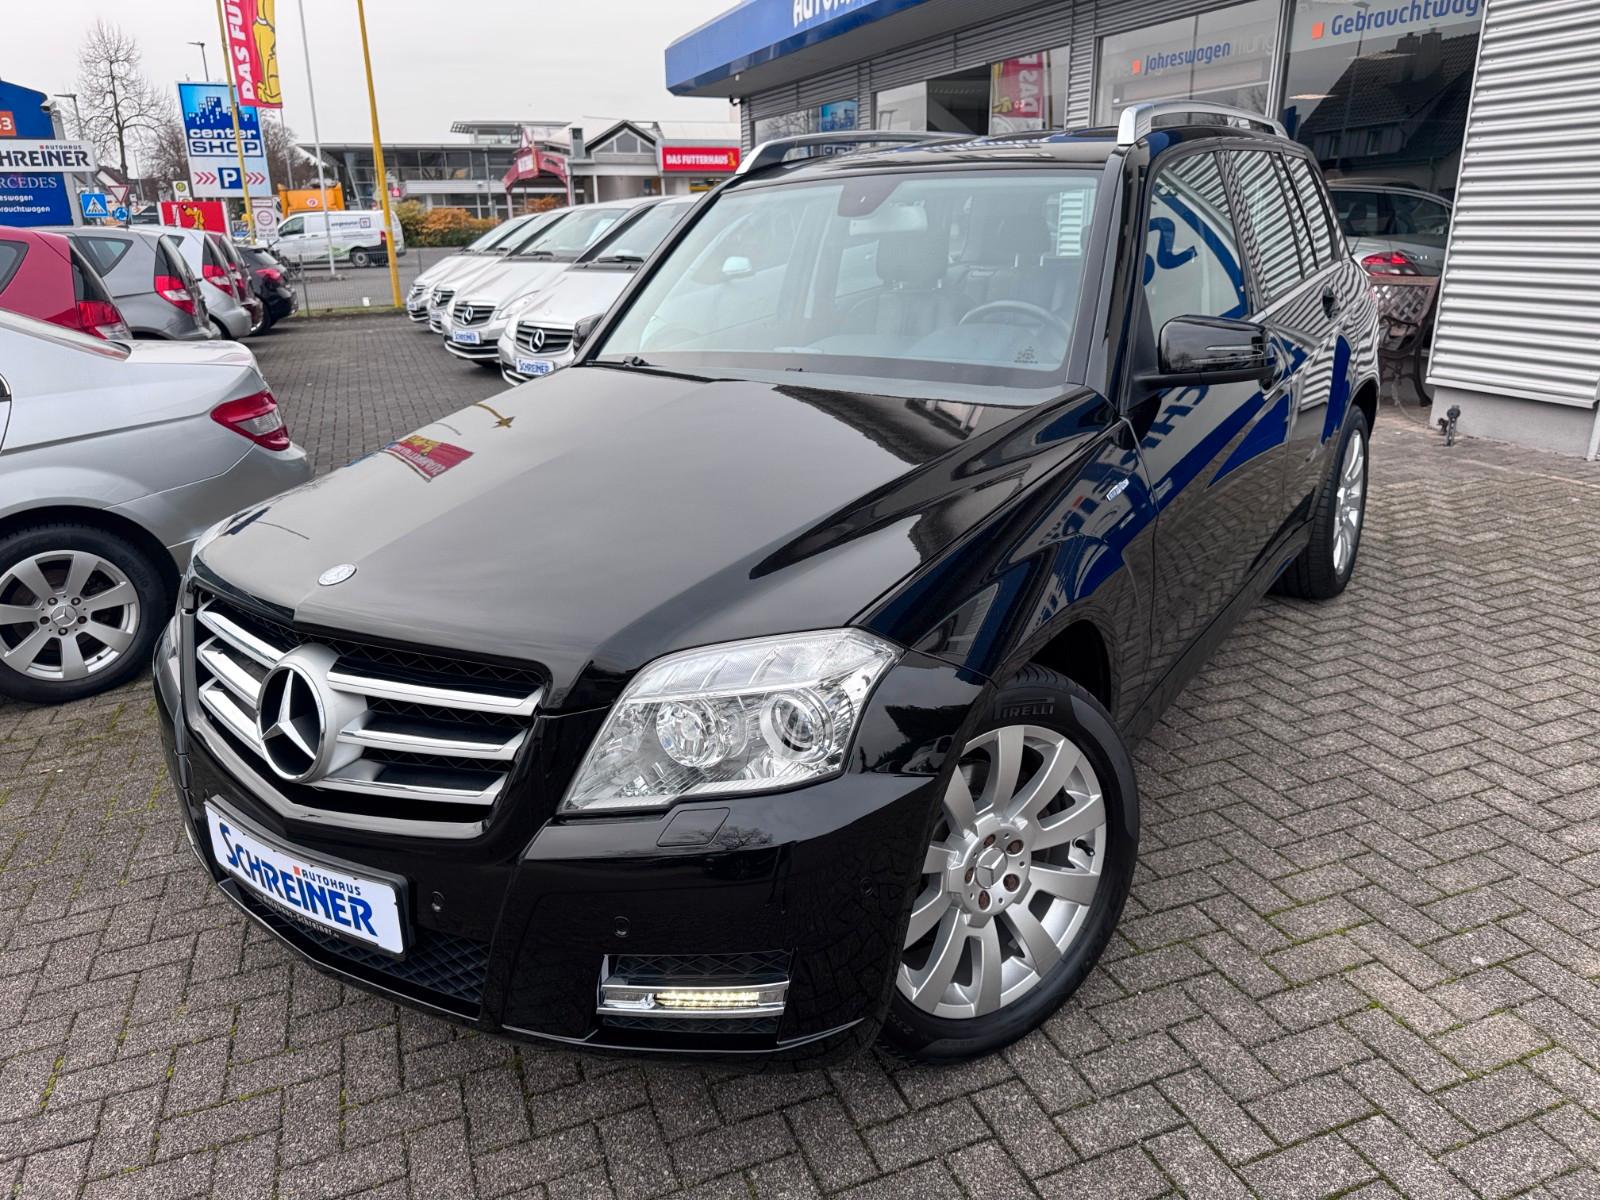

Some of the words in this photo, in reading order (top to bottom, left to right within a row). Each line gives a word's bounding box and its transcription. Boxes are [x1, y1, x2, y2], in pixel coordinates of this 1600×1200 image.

[226, 0, 247, 40] FU
[1331, 0, 1486, 36] Gebrauchtwag
[234, 46, 256, 100] DAS
[1143, 42, 1231, 75] Jahreswagen
[189, 128, 257, 139] center
[191, 140, 259, 154] SHOP
[665, 155, 681, 165] DAS
[682, 155, 729, 166] FUTTERHAUS
[222, 169, 237, 187] P
[219, 821, 379, 938] SCHREINER
[301, 870, 361, 896] AUTOHAUS
